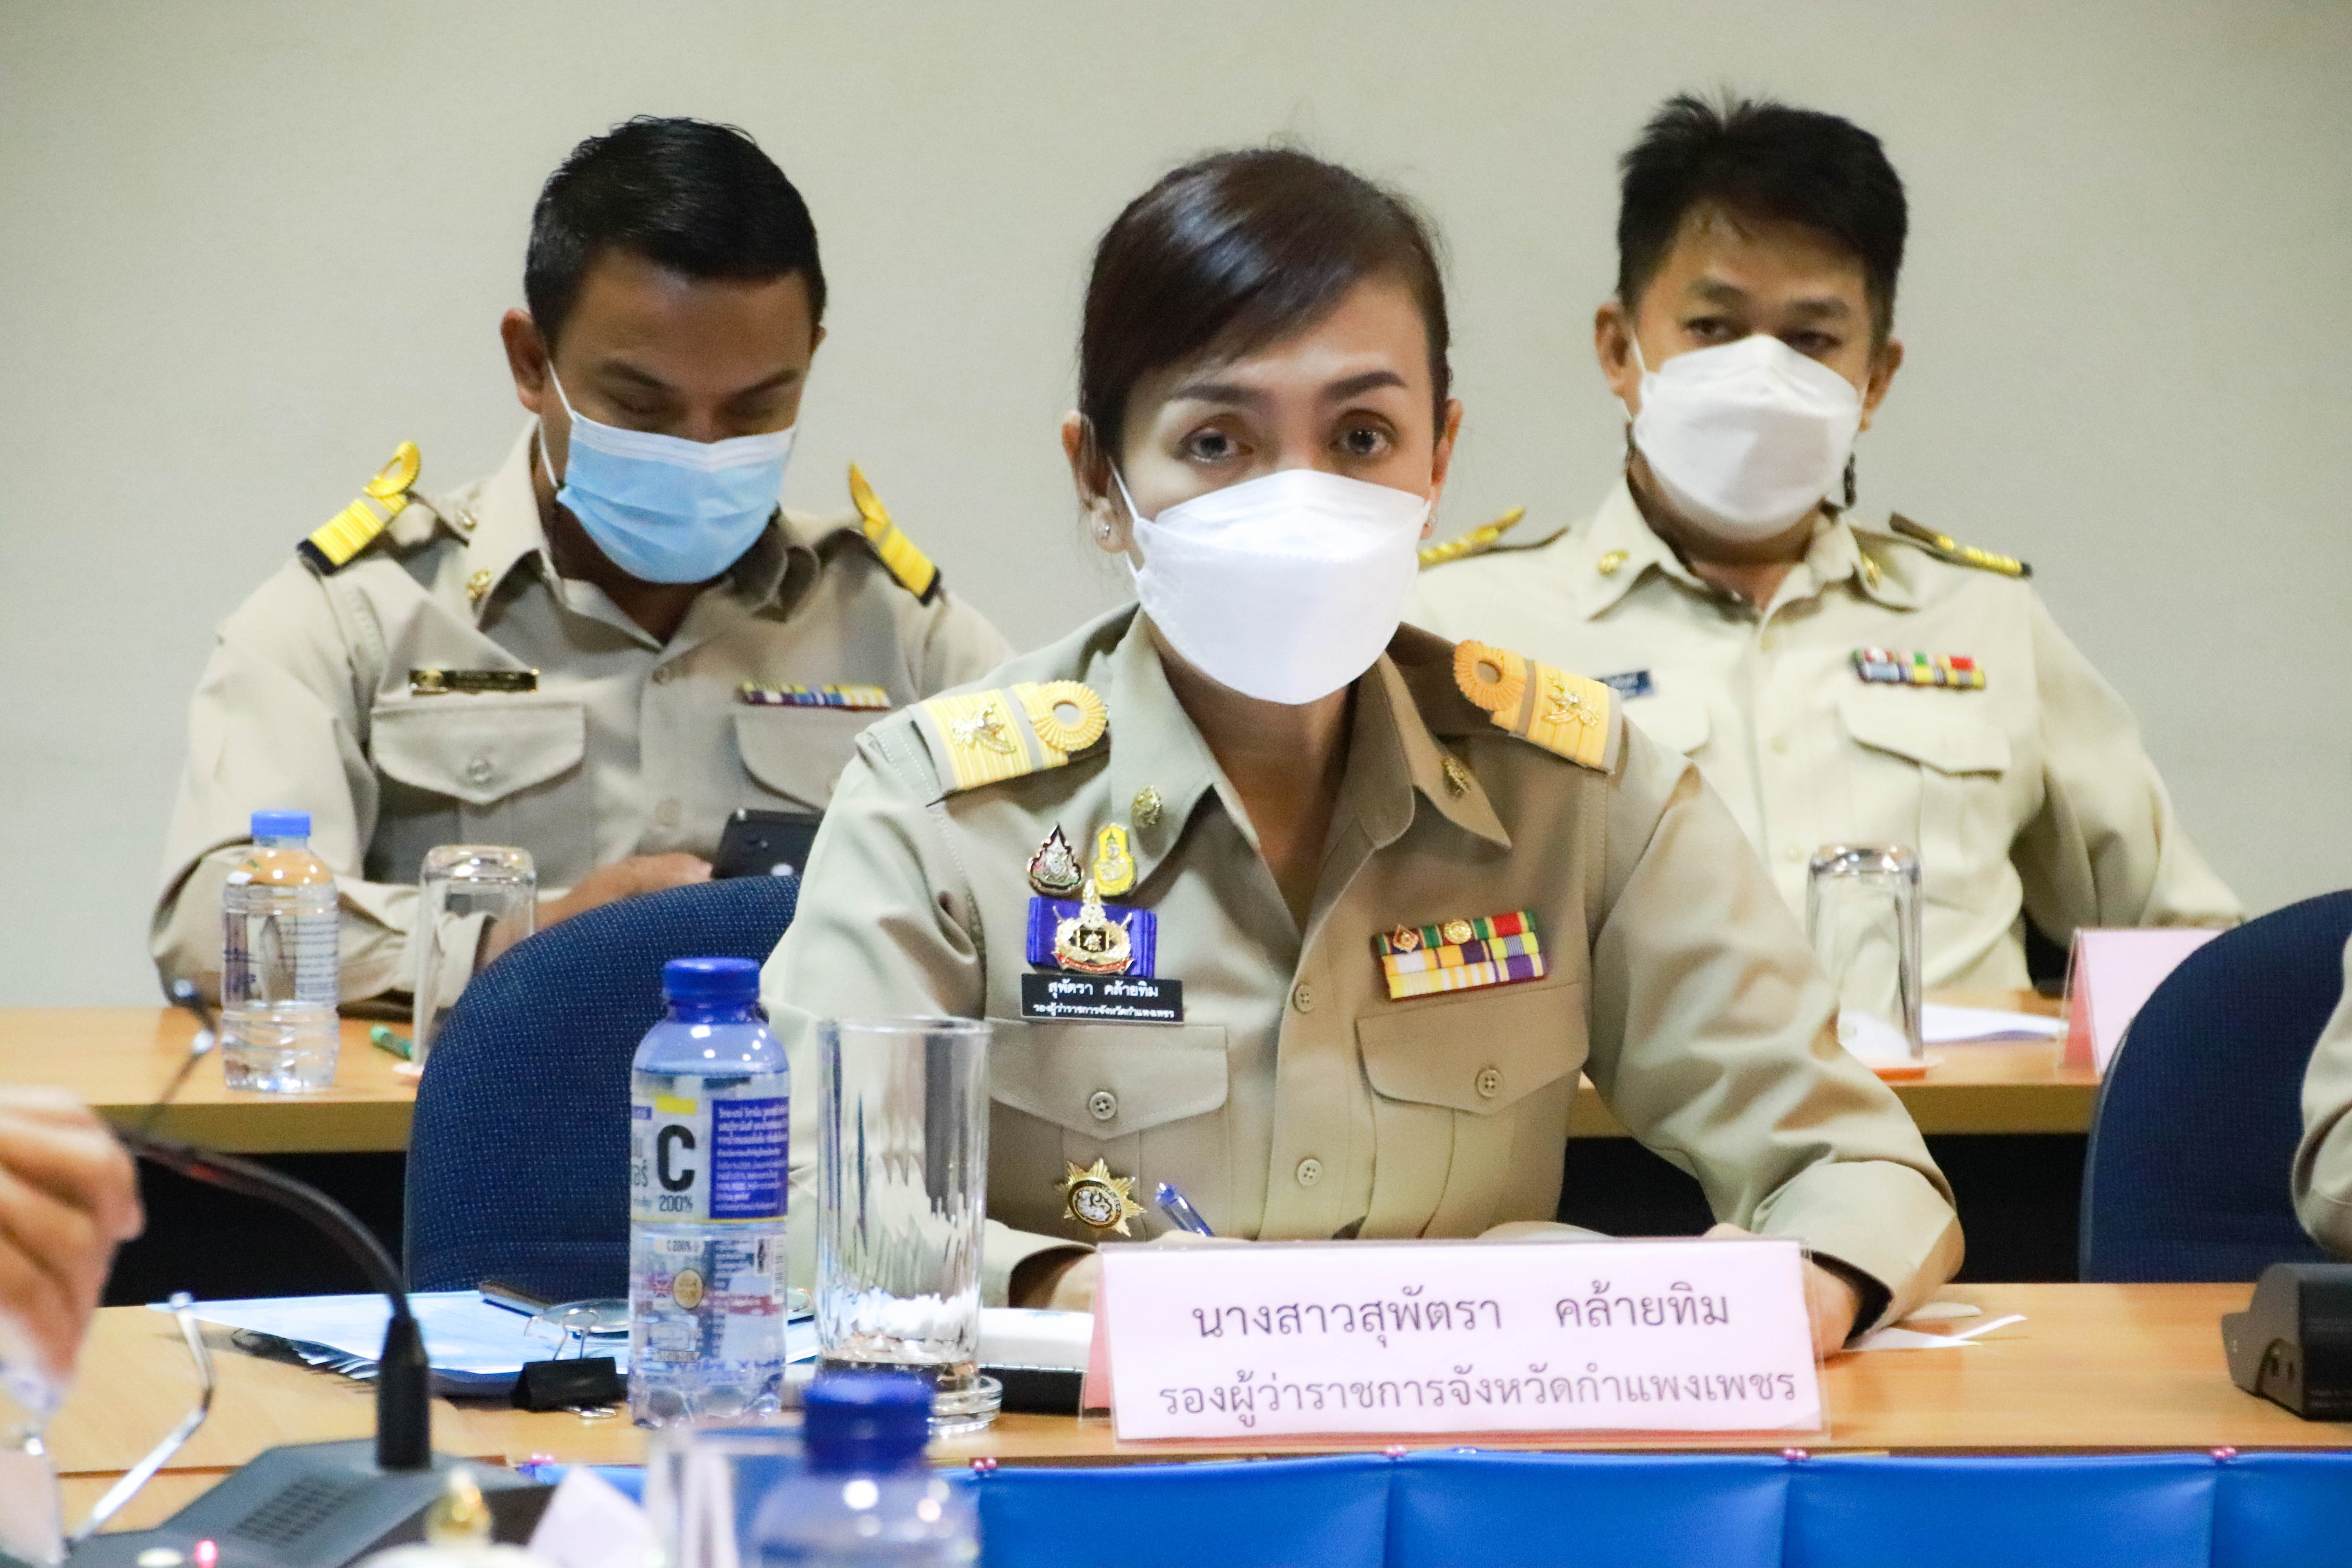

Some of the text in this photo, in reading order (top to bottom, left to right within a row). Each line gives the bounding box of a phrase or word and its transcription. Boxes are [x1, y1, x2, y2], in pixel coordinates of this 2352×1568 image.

[1048, 978, 1159, 999] สุพัตรา คล้ายทิม
[656, 1124, 696, 1192] C
[659, 1195, 693, 1213] 200%
[1192, 1279, 1729, 1348] นางสาวสุพัตรา คล้ายทิม
[1159, 1362, 1796, 1428] รองผู้ว่าราชการจังหวัดกำแพงเพชร
